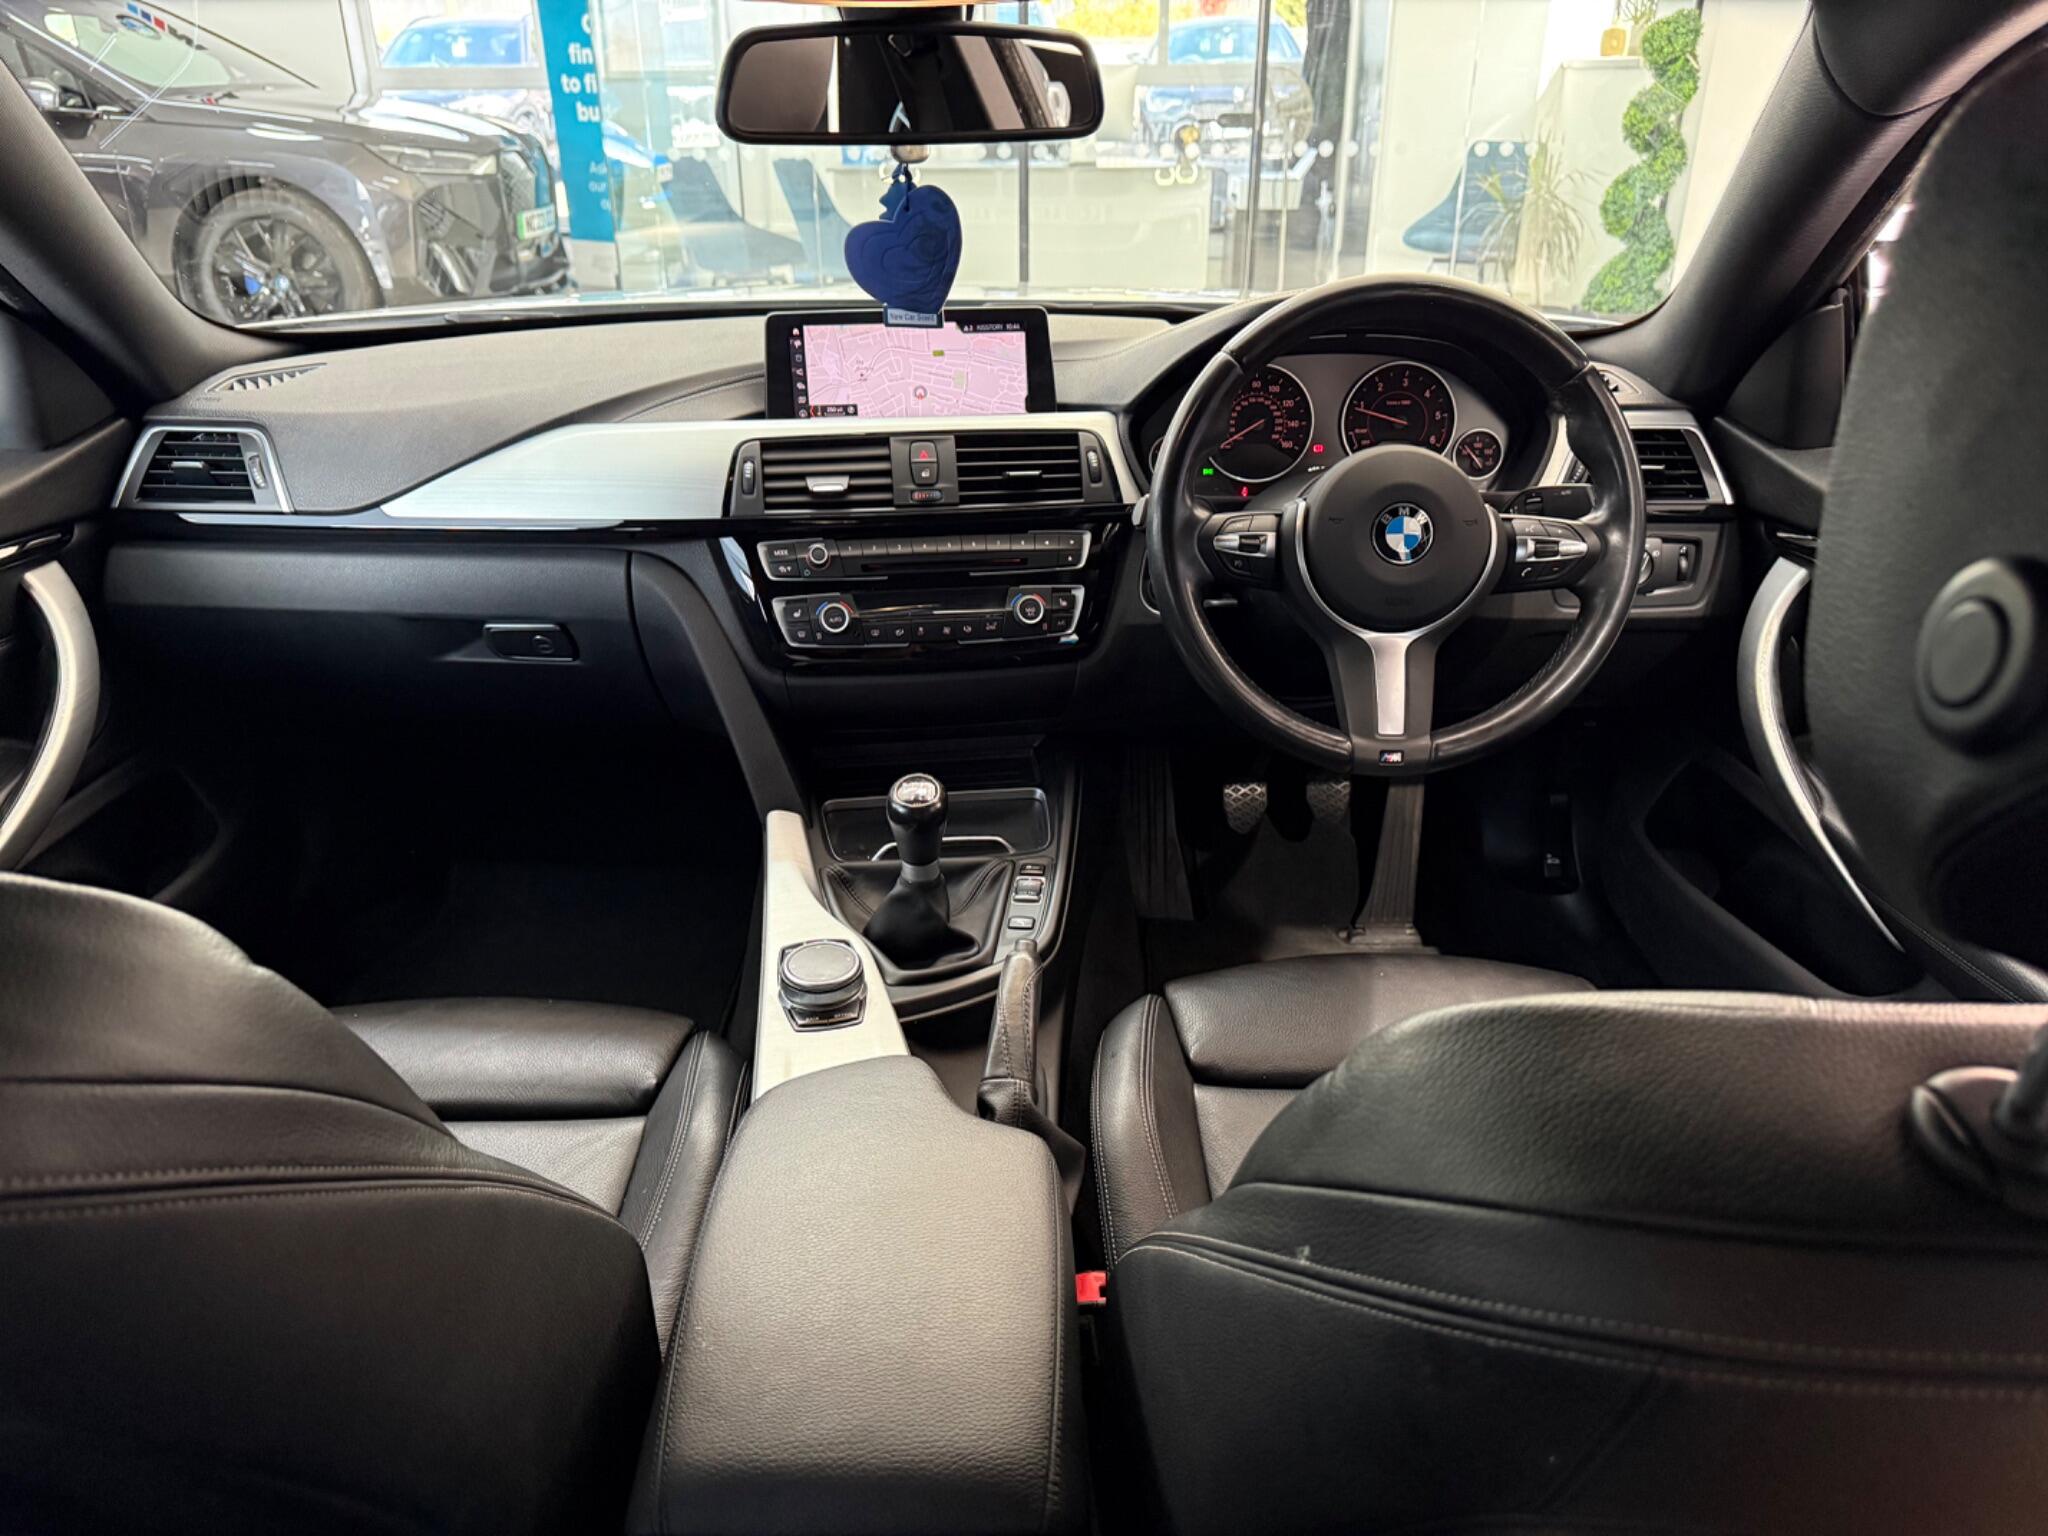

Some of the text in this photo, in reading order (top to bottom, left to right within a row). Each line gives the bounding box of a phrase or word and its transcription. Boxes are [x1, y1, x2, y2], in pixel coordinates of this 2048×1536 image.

[561, 74, 581, 94] to
[905, 312, 917, 321] Car
[1377, 382, 1384, 392] 2
[1402, 378, 1409, 387] 3
[1424, 389, 1431, 398] 4
[1381, 505, 1429, 525] BMW
